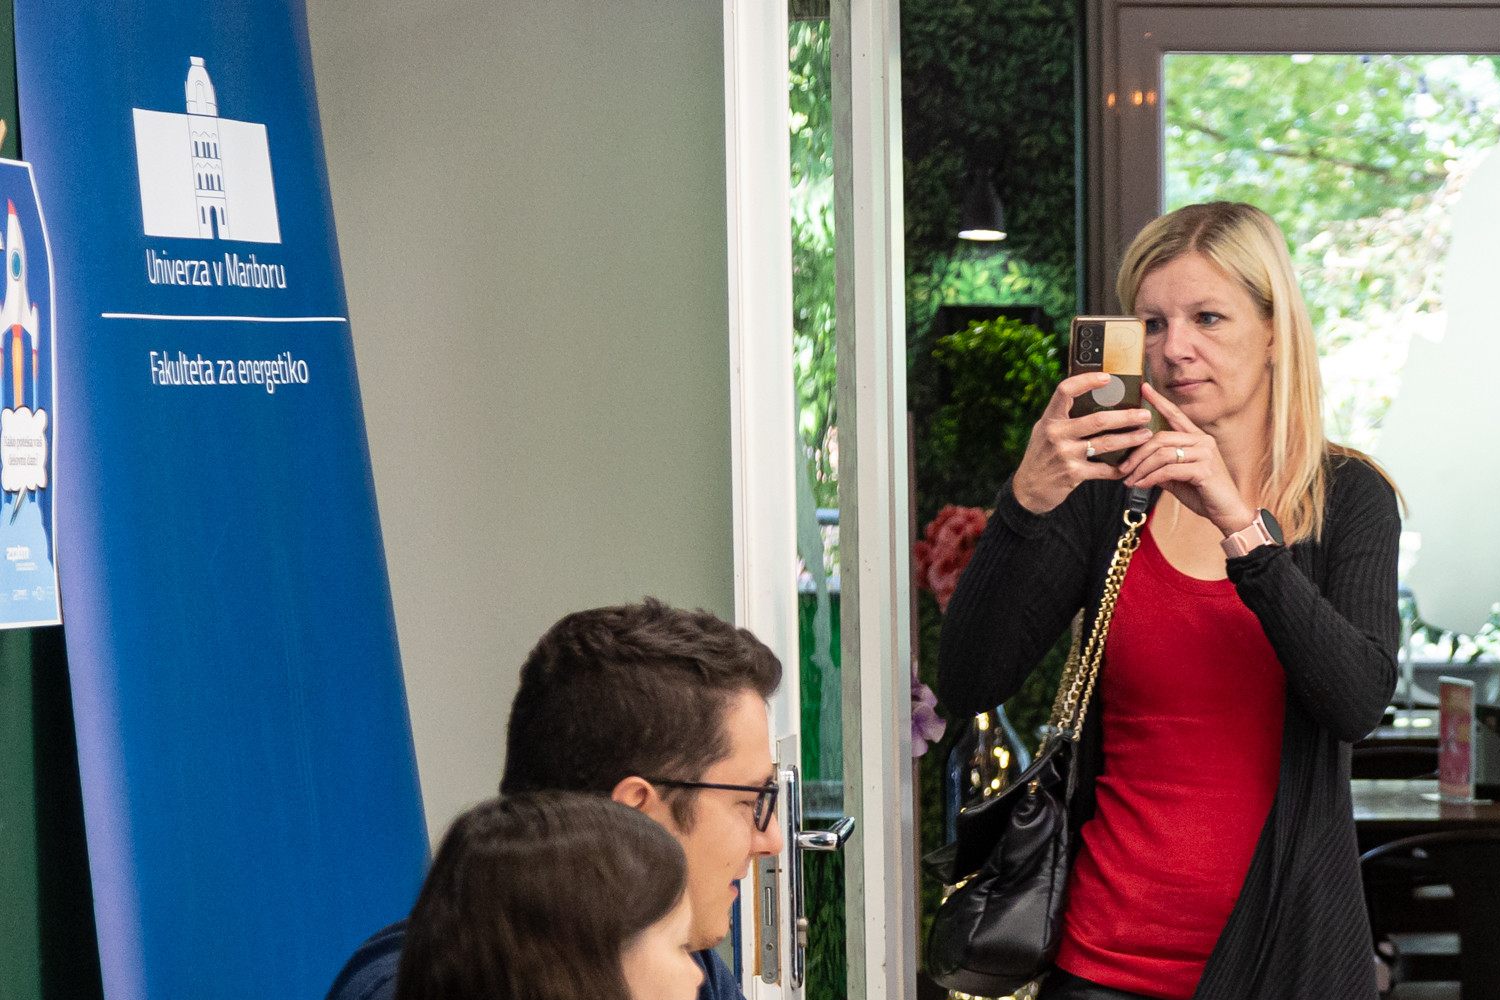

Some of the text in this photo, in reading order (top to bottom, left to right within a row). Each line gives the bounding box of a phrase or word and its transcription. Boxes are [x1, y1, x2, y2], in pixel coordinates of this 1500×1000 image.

[146, 249, 287, 289] Univerza v Mariboru
[150, 350, 309, 394] Fakulteta za energetiko
